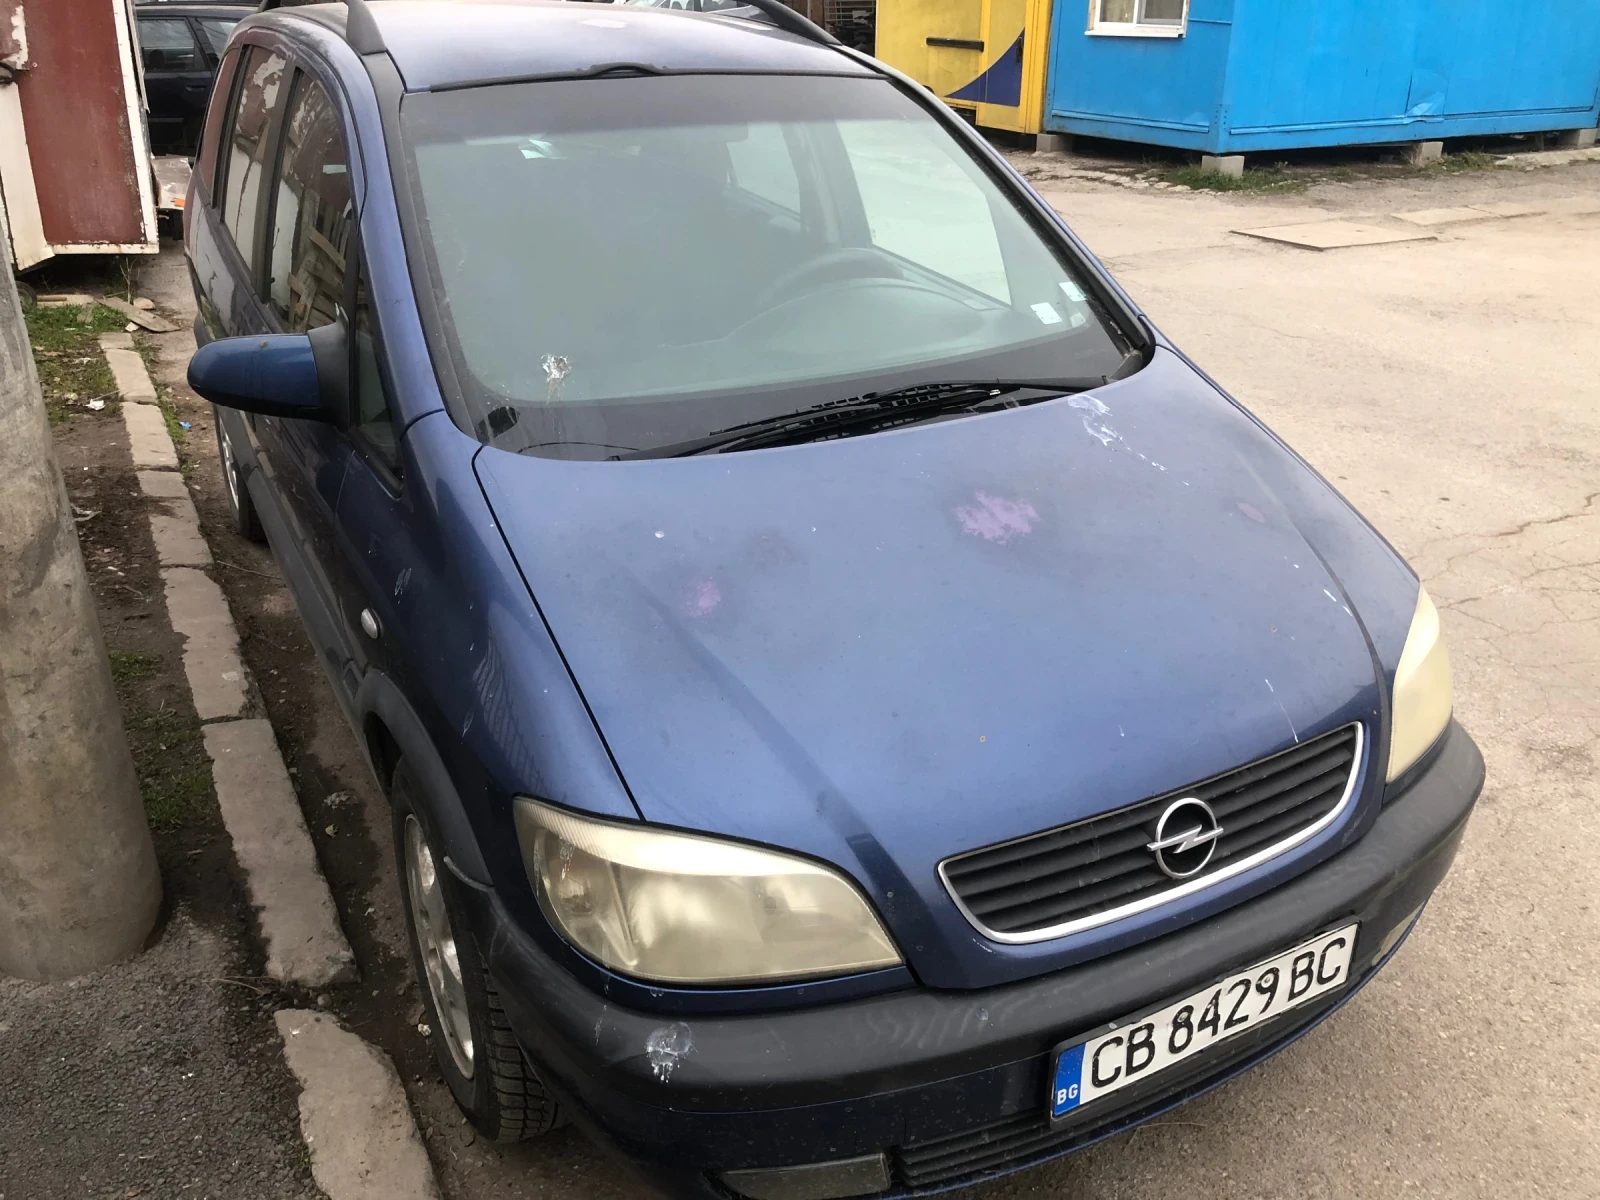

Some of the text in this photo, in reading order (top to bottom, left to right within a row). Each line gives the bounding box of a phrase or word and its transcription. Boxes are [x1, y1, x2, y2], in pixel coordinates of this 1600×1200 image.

[1091, 937, 1346, 1088] CB 8429 BC
[1057, 1084, 1079, 1105] BG
